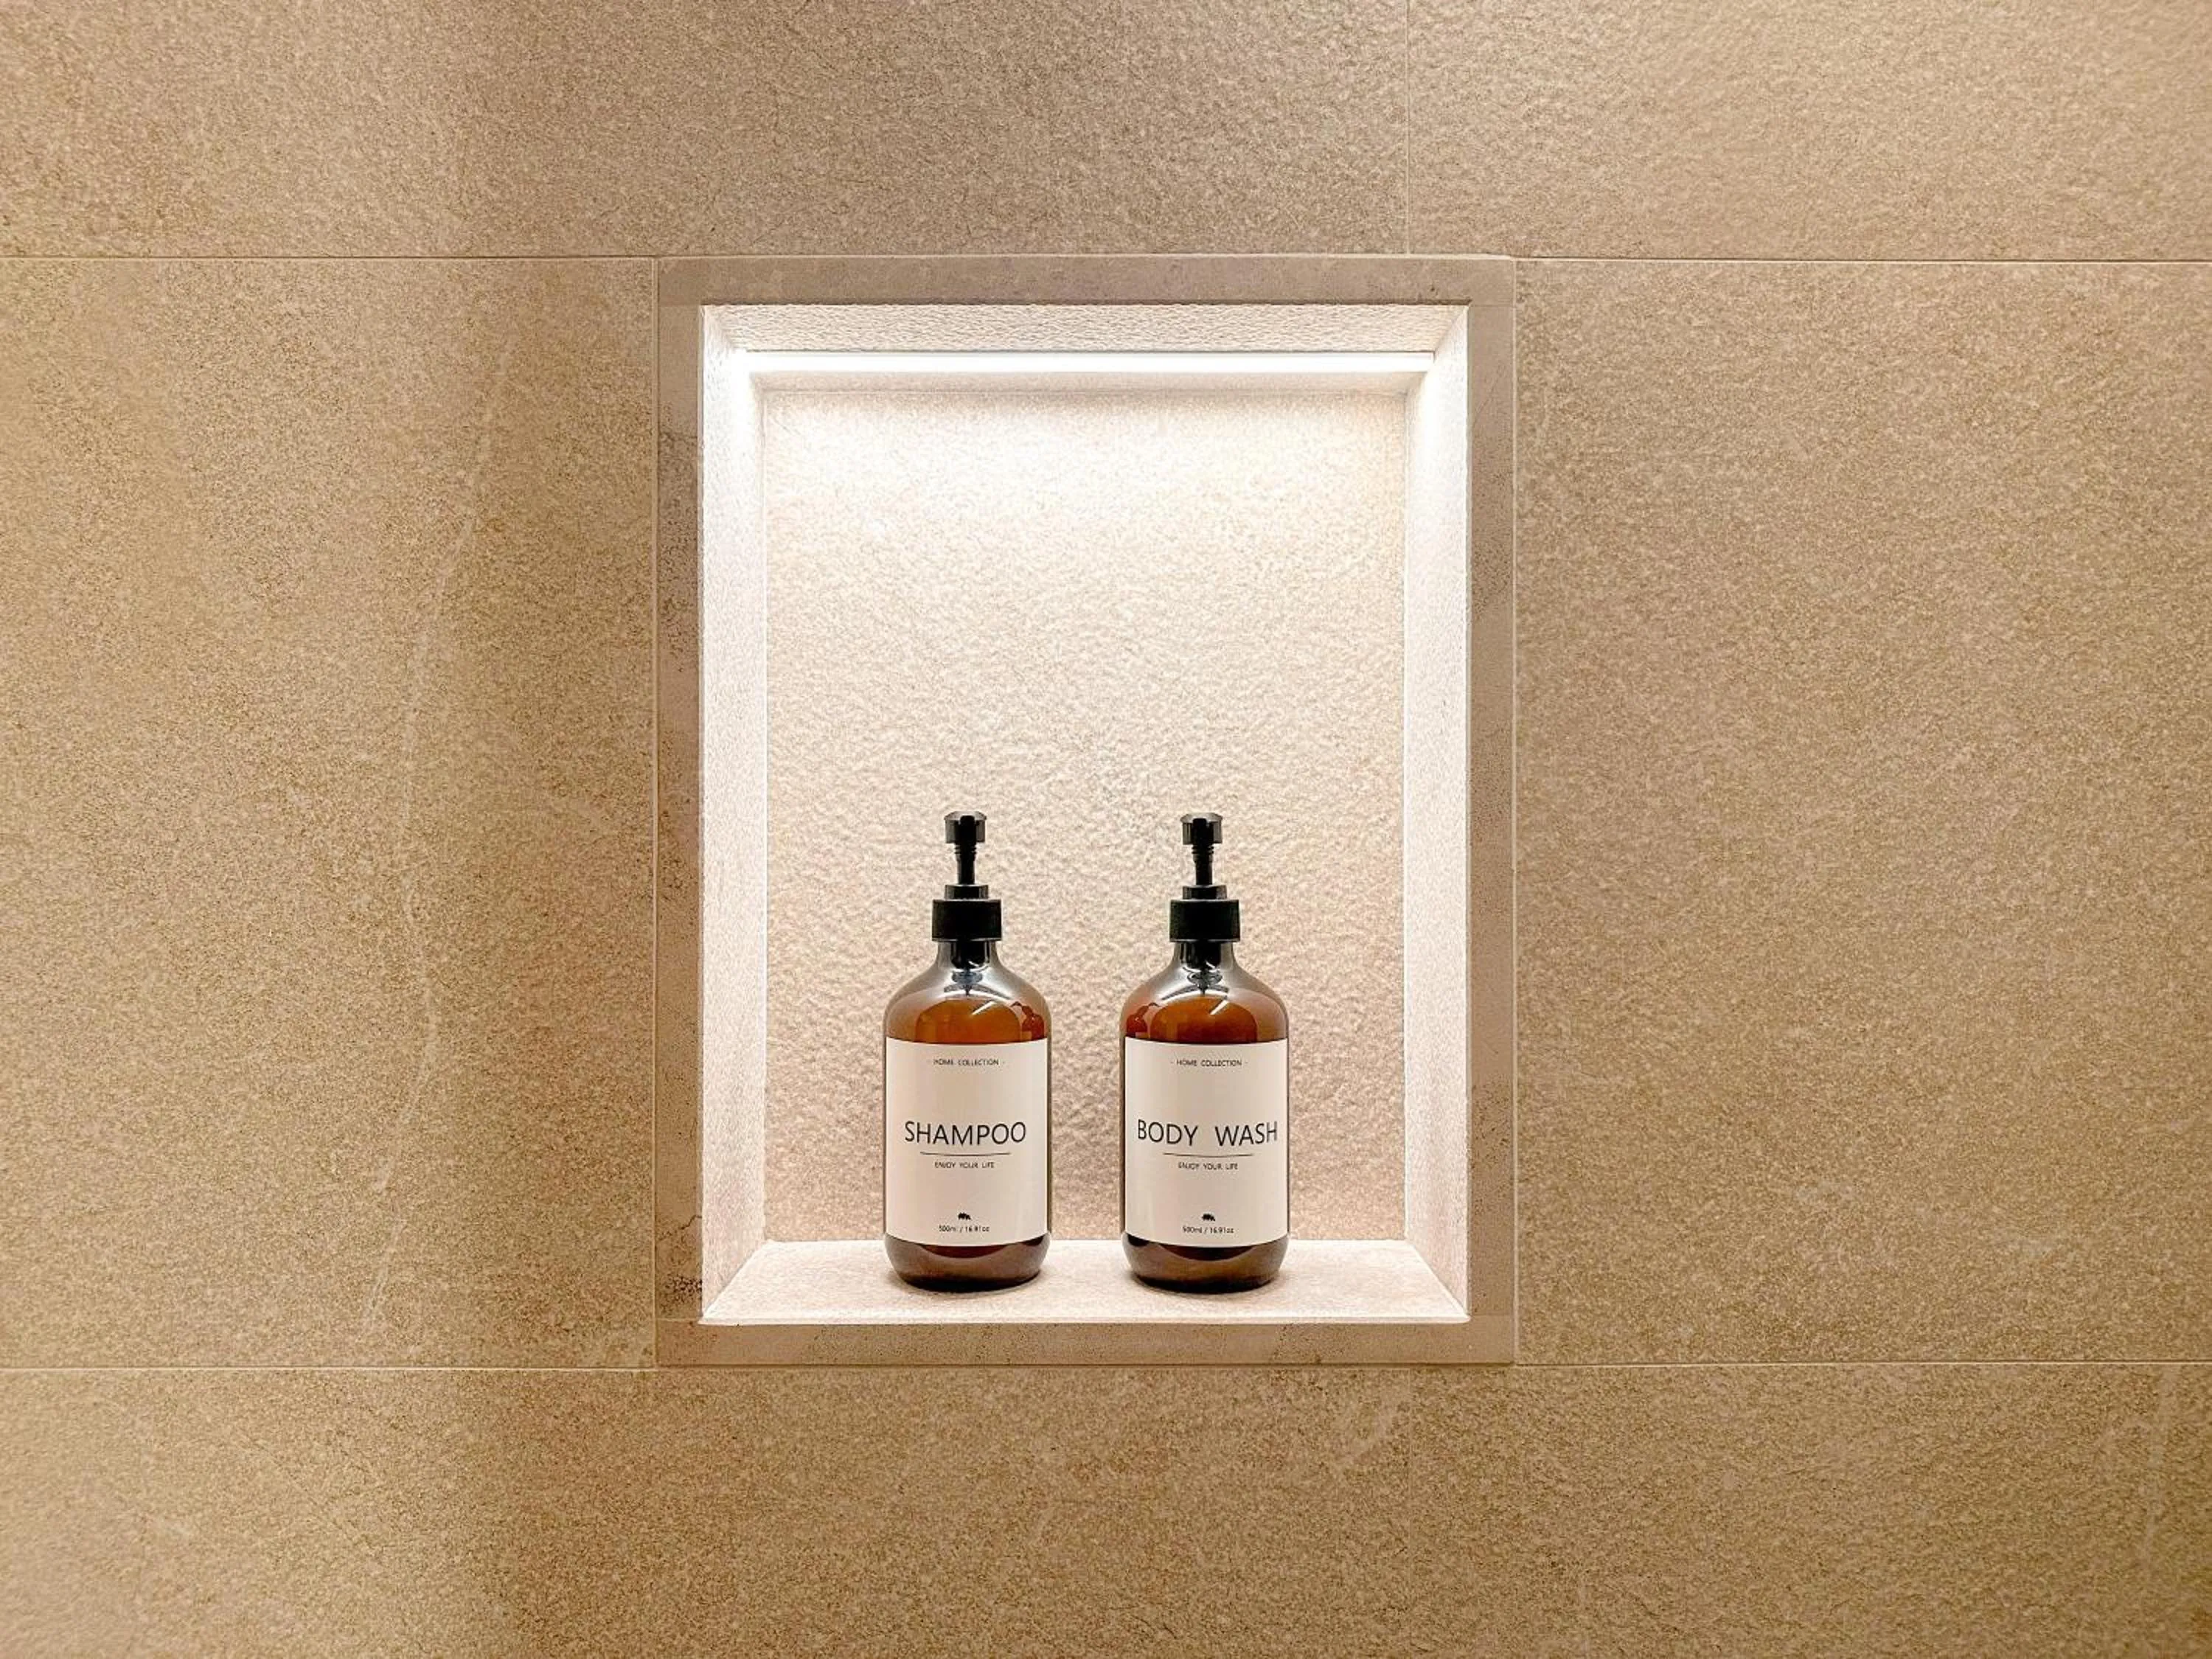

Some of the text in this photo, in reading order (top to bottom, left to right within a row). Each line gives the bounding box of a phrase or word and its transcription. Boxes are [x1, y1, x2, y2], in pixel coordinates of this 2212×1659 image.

[957, 1058, 999, 1066] COLLECTION
[1176, 1058, 1242, 1067] HOME COLLECTION
[904, 1120, 1026, 1146] SHAMPOO
[1138, 1119, 1278, 1147] BODY WASH
[1178, 1161, 1238, 1170] ENJOY YOUR LIFE
